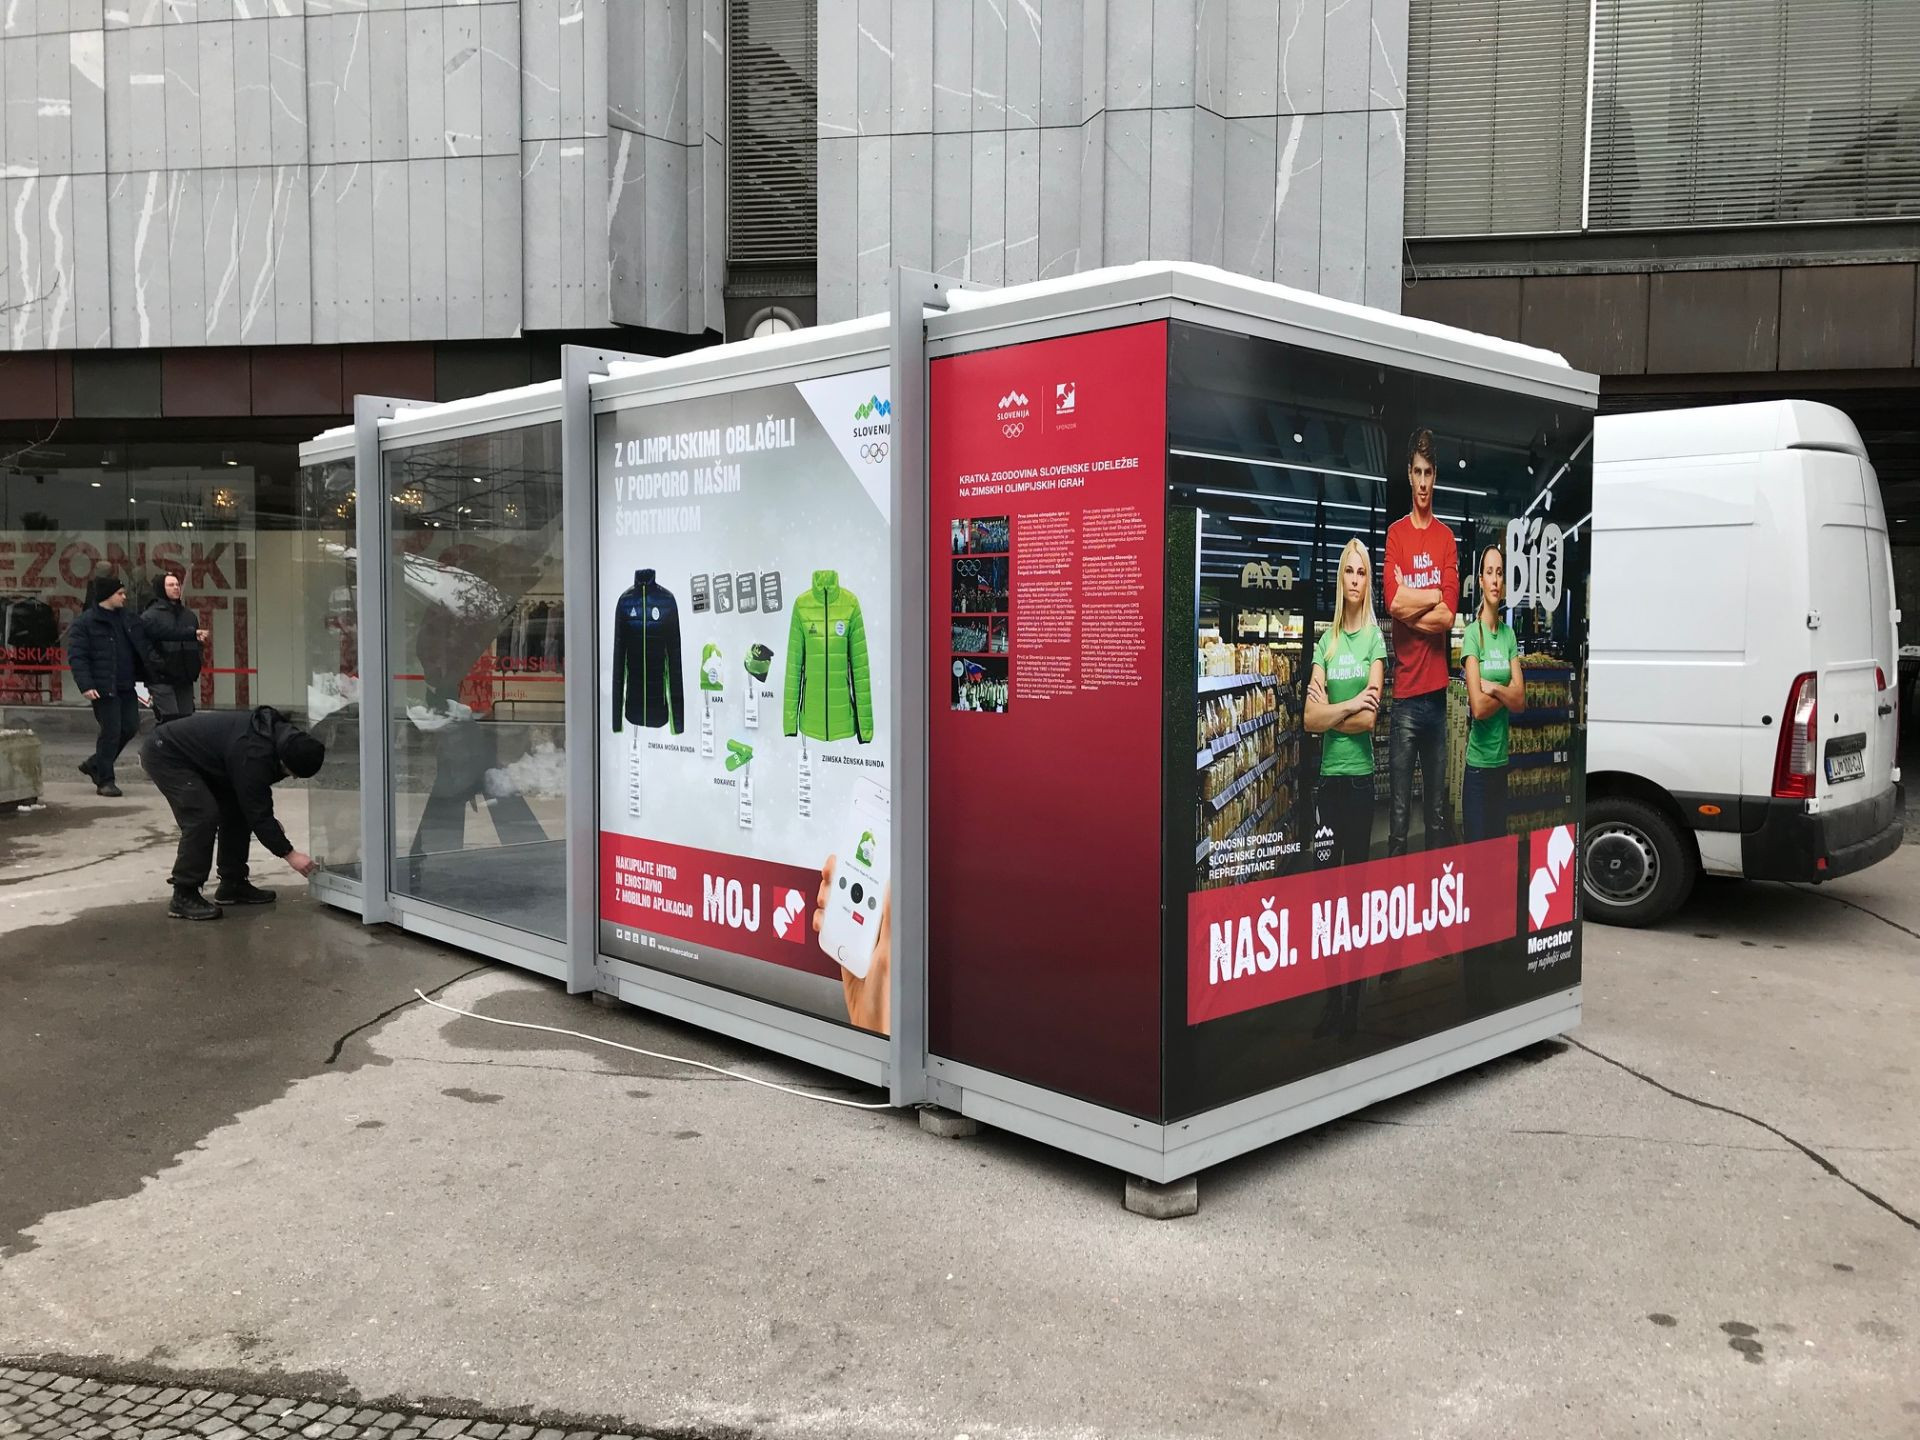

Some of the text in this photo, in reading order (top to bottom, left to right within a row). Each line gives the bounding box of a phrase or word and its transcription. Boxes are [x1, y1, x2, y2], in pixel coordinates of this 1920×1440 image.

[997, 410, 1030, 421] SLOVENIJA
[615, 415, 796, 468] Z OLIMPIJSKIMI OBLAČILI
[853, 423, 890, 438] SLOVENIJ
[615, 460, 741, 502] V PODPORO NAŠIM
[959, 456, 1139, 485] KRATKA ZGODOVINA SLOVENSKE UDELEŽBE
[959, 477, 1085, 497] NA ZIMSKIH OLIMPIJSKIH IGRAH
[615, 505, 701, 537] ŠPORTNIKOM
[1413, 552, 1433, 569] NAŠI.
[680, 745, 695, 753] BUNDA
[822, 755, 885, 768] ZIMSKA ŽENSKA BUNDA
[713, 778, 736, 787] ROKAVICE
[1209, 832, 1283, 851] PONOSNI SPONZOR
[1314, 840, 1335, 848] SLOVENIJA
[1209, 842, 1301, 866] SLOVENSKE OLIMPIJSKE
[616, 855, 677, 880] NAKUPUJTE HITRO
[1209, 860, 1275, 880] REPREZENTANCE
[616, 872, 662, 894] IN ENOSTAVNO
[616, 888, 693, 918] Z MOBILNO APLIKACIJO
[703, 873, 761, 932] MOJ
[1209, 896, 1298, 985] NAŠI.
[1311, 861, 1471, 960] NAJBOLJŠI.
[1528, 930, 1573, 954] Mercator
